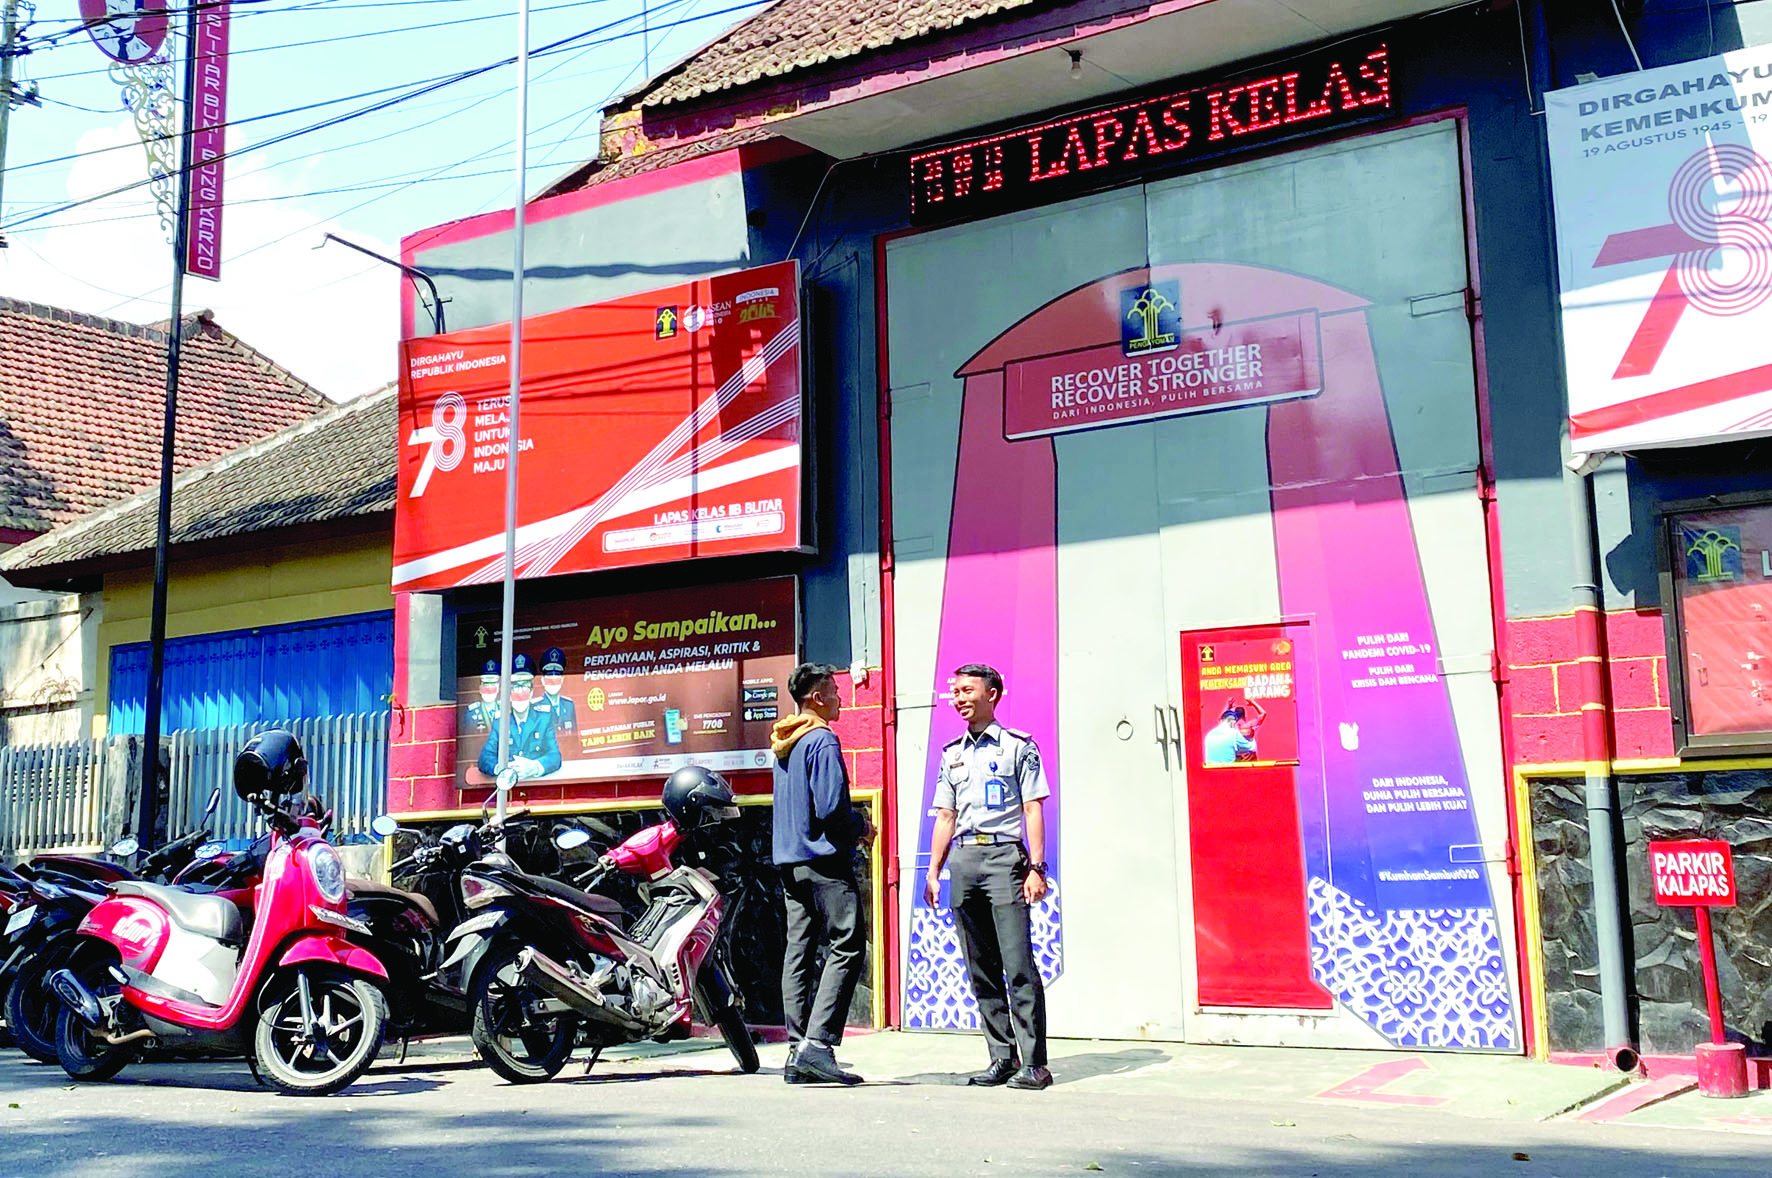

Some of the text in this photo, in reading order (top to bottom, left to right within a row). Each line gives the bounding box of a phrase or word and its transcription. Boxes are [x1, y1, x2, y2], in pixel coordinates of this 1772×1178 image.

[1579, 64, 1772, 117] DIRGAHAYU
[202, 92, 219, 145] BUMI
[1029, 99, 1192, 182] LAPAS
[1207, 50, 1389, 141] KELAS
[1584, 147, 1600, 158] 19
[1604, 129, 1687, 154] AGUSTUS
[1693, 120, 1732, 136] 1945
[197, 203, 215, 270] KARNO
[410, 350, 464, 367] DIRGAHAYU
[410, 354, 507, 380] REPUBLIK INDONESIA
[1051, 343, 1262, 393] RECOVER TOGETHER
[1051, 361, 1263, 409] RECOVER STRONGER
[476, 395, 512, 412] TERUS
[1053, 380, 1263, 420] DARI INDONESIA, PULIH BERSAMA
[407, 391, 467, 498] 78
[473, 438, 534, 458] INDONSIA
[473, 458, 505, 474] MAJU
[654, 510, 689, 525] LAPAS
[691, 505, 726, 521] KELAS
[744, 498, 783, 514] BLITAR
[586, 625, 628, 648] Ayo
[633, 610, 777, 641] Sampaikan...
[1357, 632, 1410, 646] PULIH DARI
[583, 641, 761, 667] PERTANYAAN, ASPIRASI, KRITIK &
[1342, 644, 1432, 660] PANDEMI COVID-19
[583, 658, 733, 682] PENGADUAN ANDA MELALUI
[1201, 666, 1222, 676] ANDA
[1368, 664, 1415, 676] PULIH DARI
[752, 711, 763, 720] App
[1363, 787, 1465, 801] DUNIA PULIH BERSAMA
[1366, 800, 1468, 813] DAN PULIH LEBIH KUAT
[1654, 852, 1727, 875] PARKIR
[1656, 874, 1730, 897] KALAPAS
